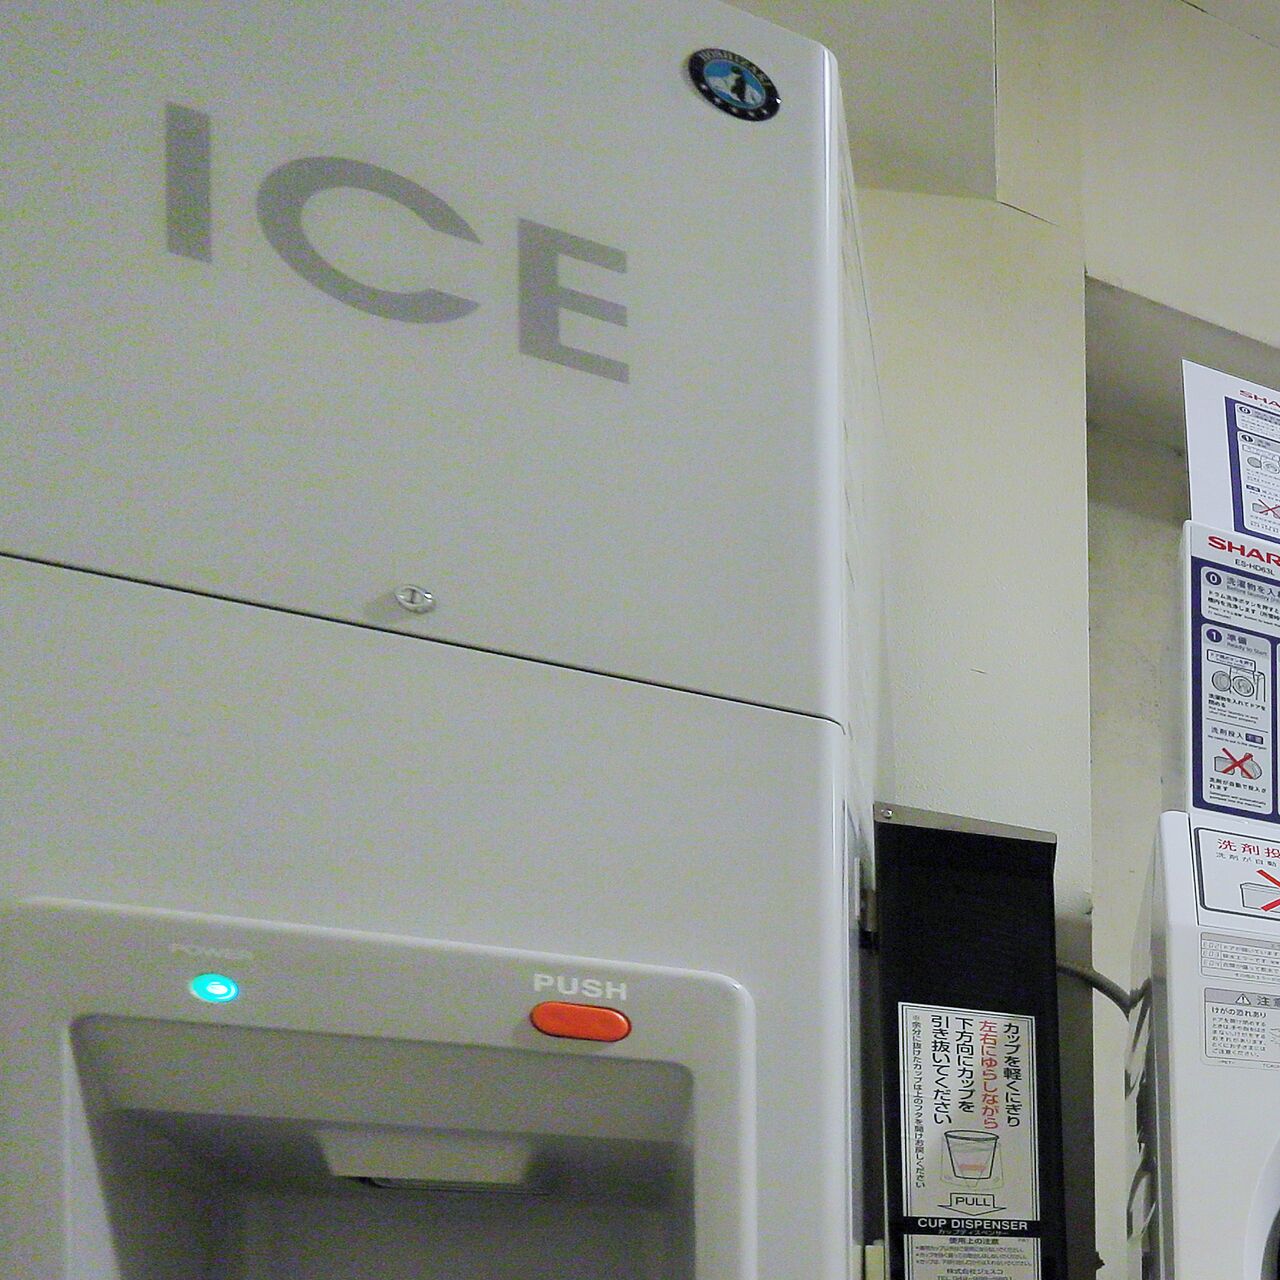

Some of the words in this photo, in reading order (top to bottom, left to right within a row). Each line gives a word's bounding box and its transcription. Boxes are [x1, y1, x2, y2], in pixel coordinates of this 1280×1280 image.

[164, 102, 629, 384] ICE
[534, 973, 628, 1001] PUSH
[1211, 1006, 1267, 1018] けがの恐れあり
[931, 1014, 952, 1124] 引き抜いてください
[955, 1016, 975, 1113] 下方向にカップを
[979, 1019, 999, 1130] 左右にゆらしながら
[1003, 1022, 1022, 1128] カップを軽くにぎり
[918, 1218, 947, 1228] CUP
[951, 1219, 1028, 1231] DISPENSER
[955, 1196, 991, 1207] PULL
